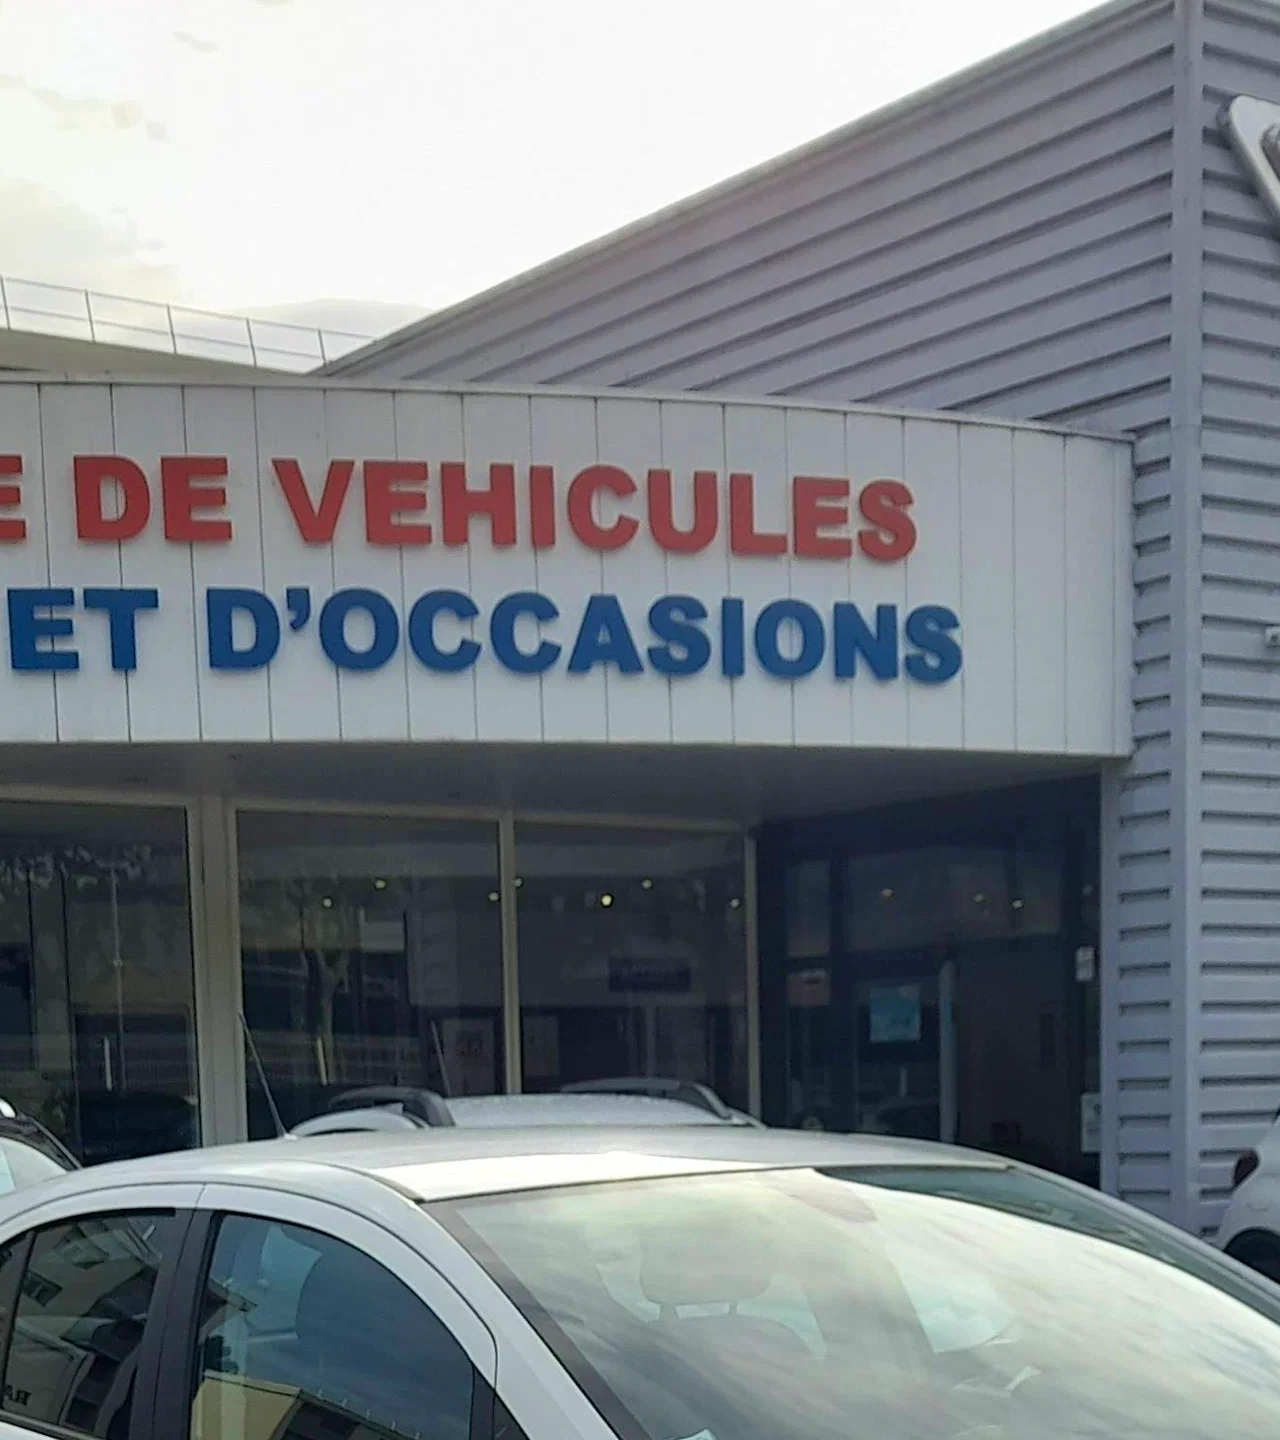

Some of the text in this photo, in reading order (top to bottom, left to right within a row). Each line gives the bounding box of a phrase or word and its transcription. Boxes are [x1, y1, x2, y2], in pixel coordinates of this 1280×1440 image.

[73, 455, 233, 542] DE
[272, 458, 917, 561] VEHICULES
[7, 587, 159, 672] ET
[206, 586, 963, 683] D'OCCASIONS
